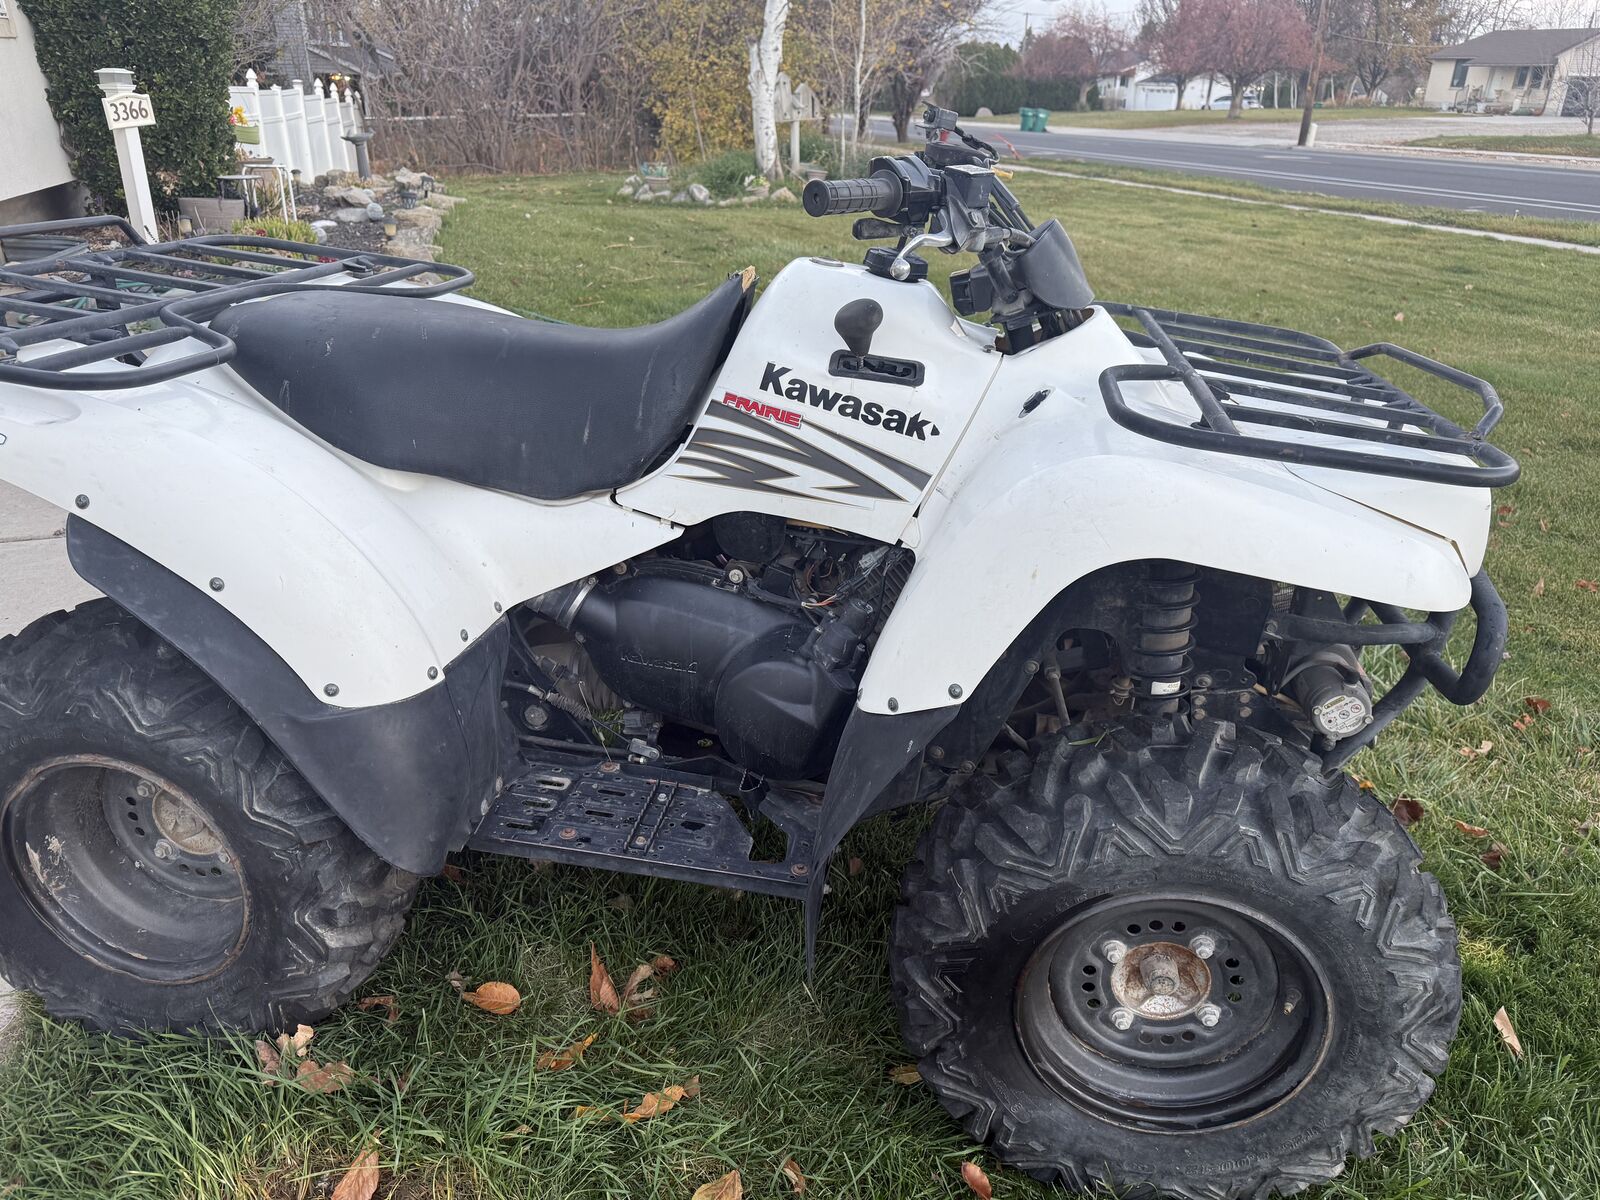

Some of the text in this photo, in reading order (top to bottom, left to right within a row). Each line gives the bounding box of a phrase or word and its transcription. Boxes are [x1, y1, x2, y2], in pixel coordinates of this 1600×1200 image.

[109, 100, 149, 122] 3366
[722, 391, 802, 429] PRAIRIE
[759, 361, 940, 441] Kawasak
